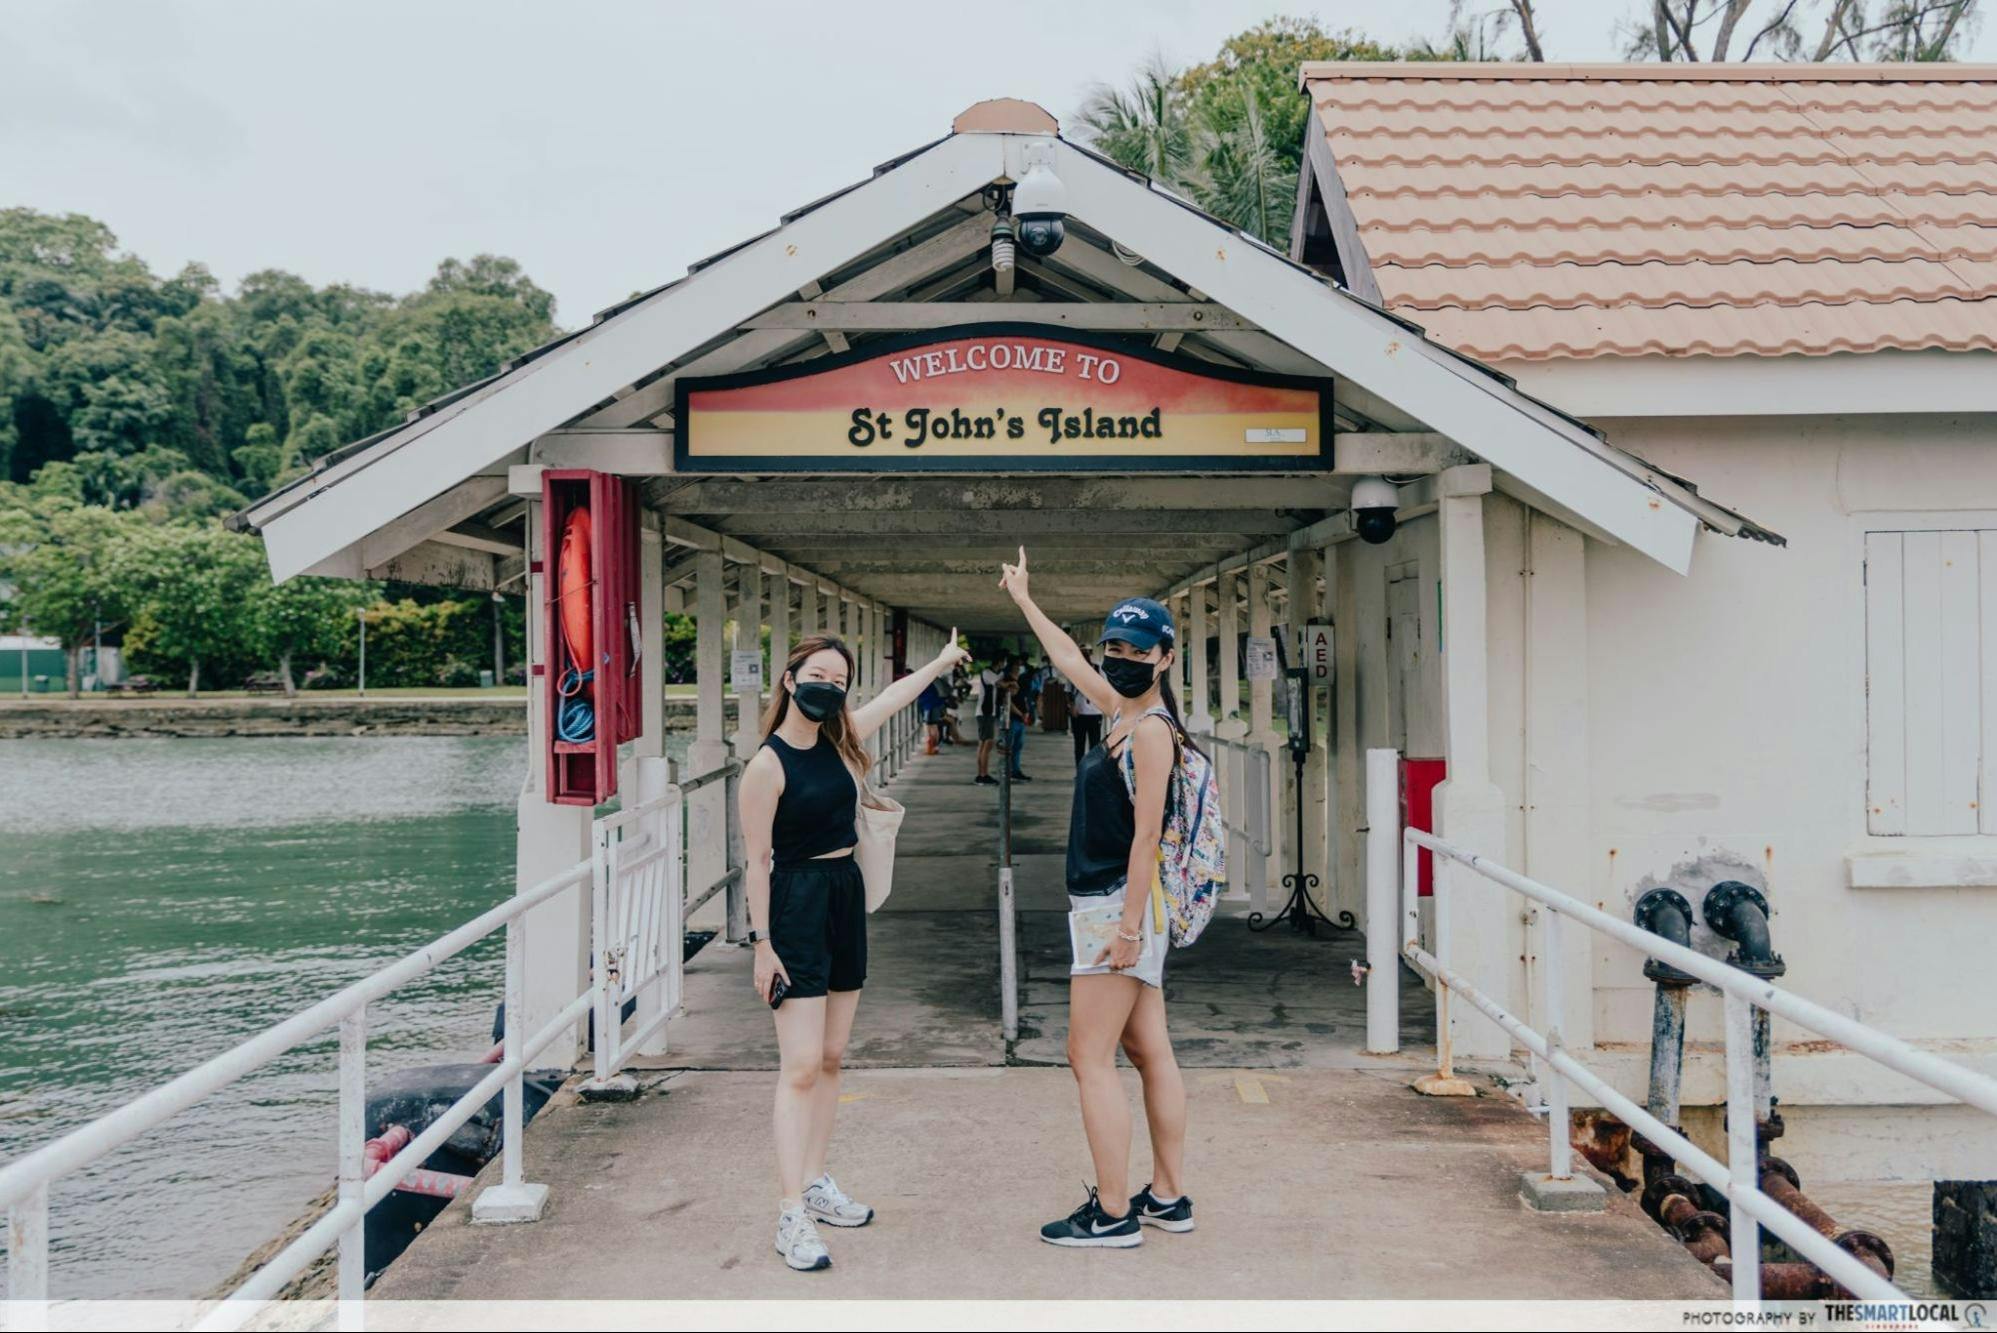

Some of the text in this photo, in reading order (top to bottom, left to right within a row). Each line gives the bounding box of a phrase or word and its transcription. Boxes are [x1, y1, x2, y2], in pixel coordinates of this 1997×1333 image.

[890, 344, 1121, 385] WELCOME TO
[848, 406, 1163, 449] St John's Island
[1315, 632, 1328, 679] AED
